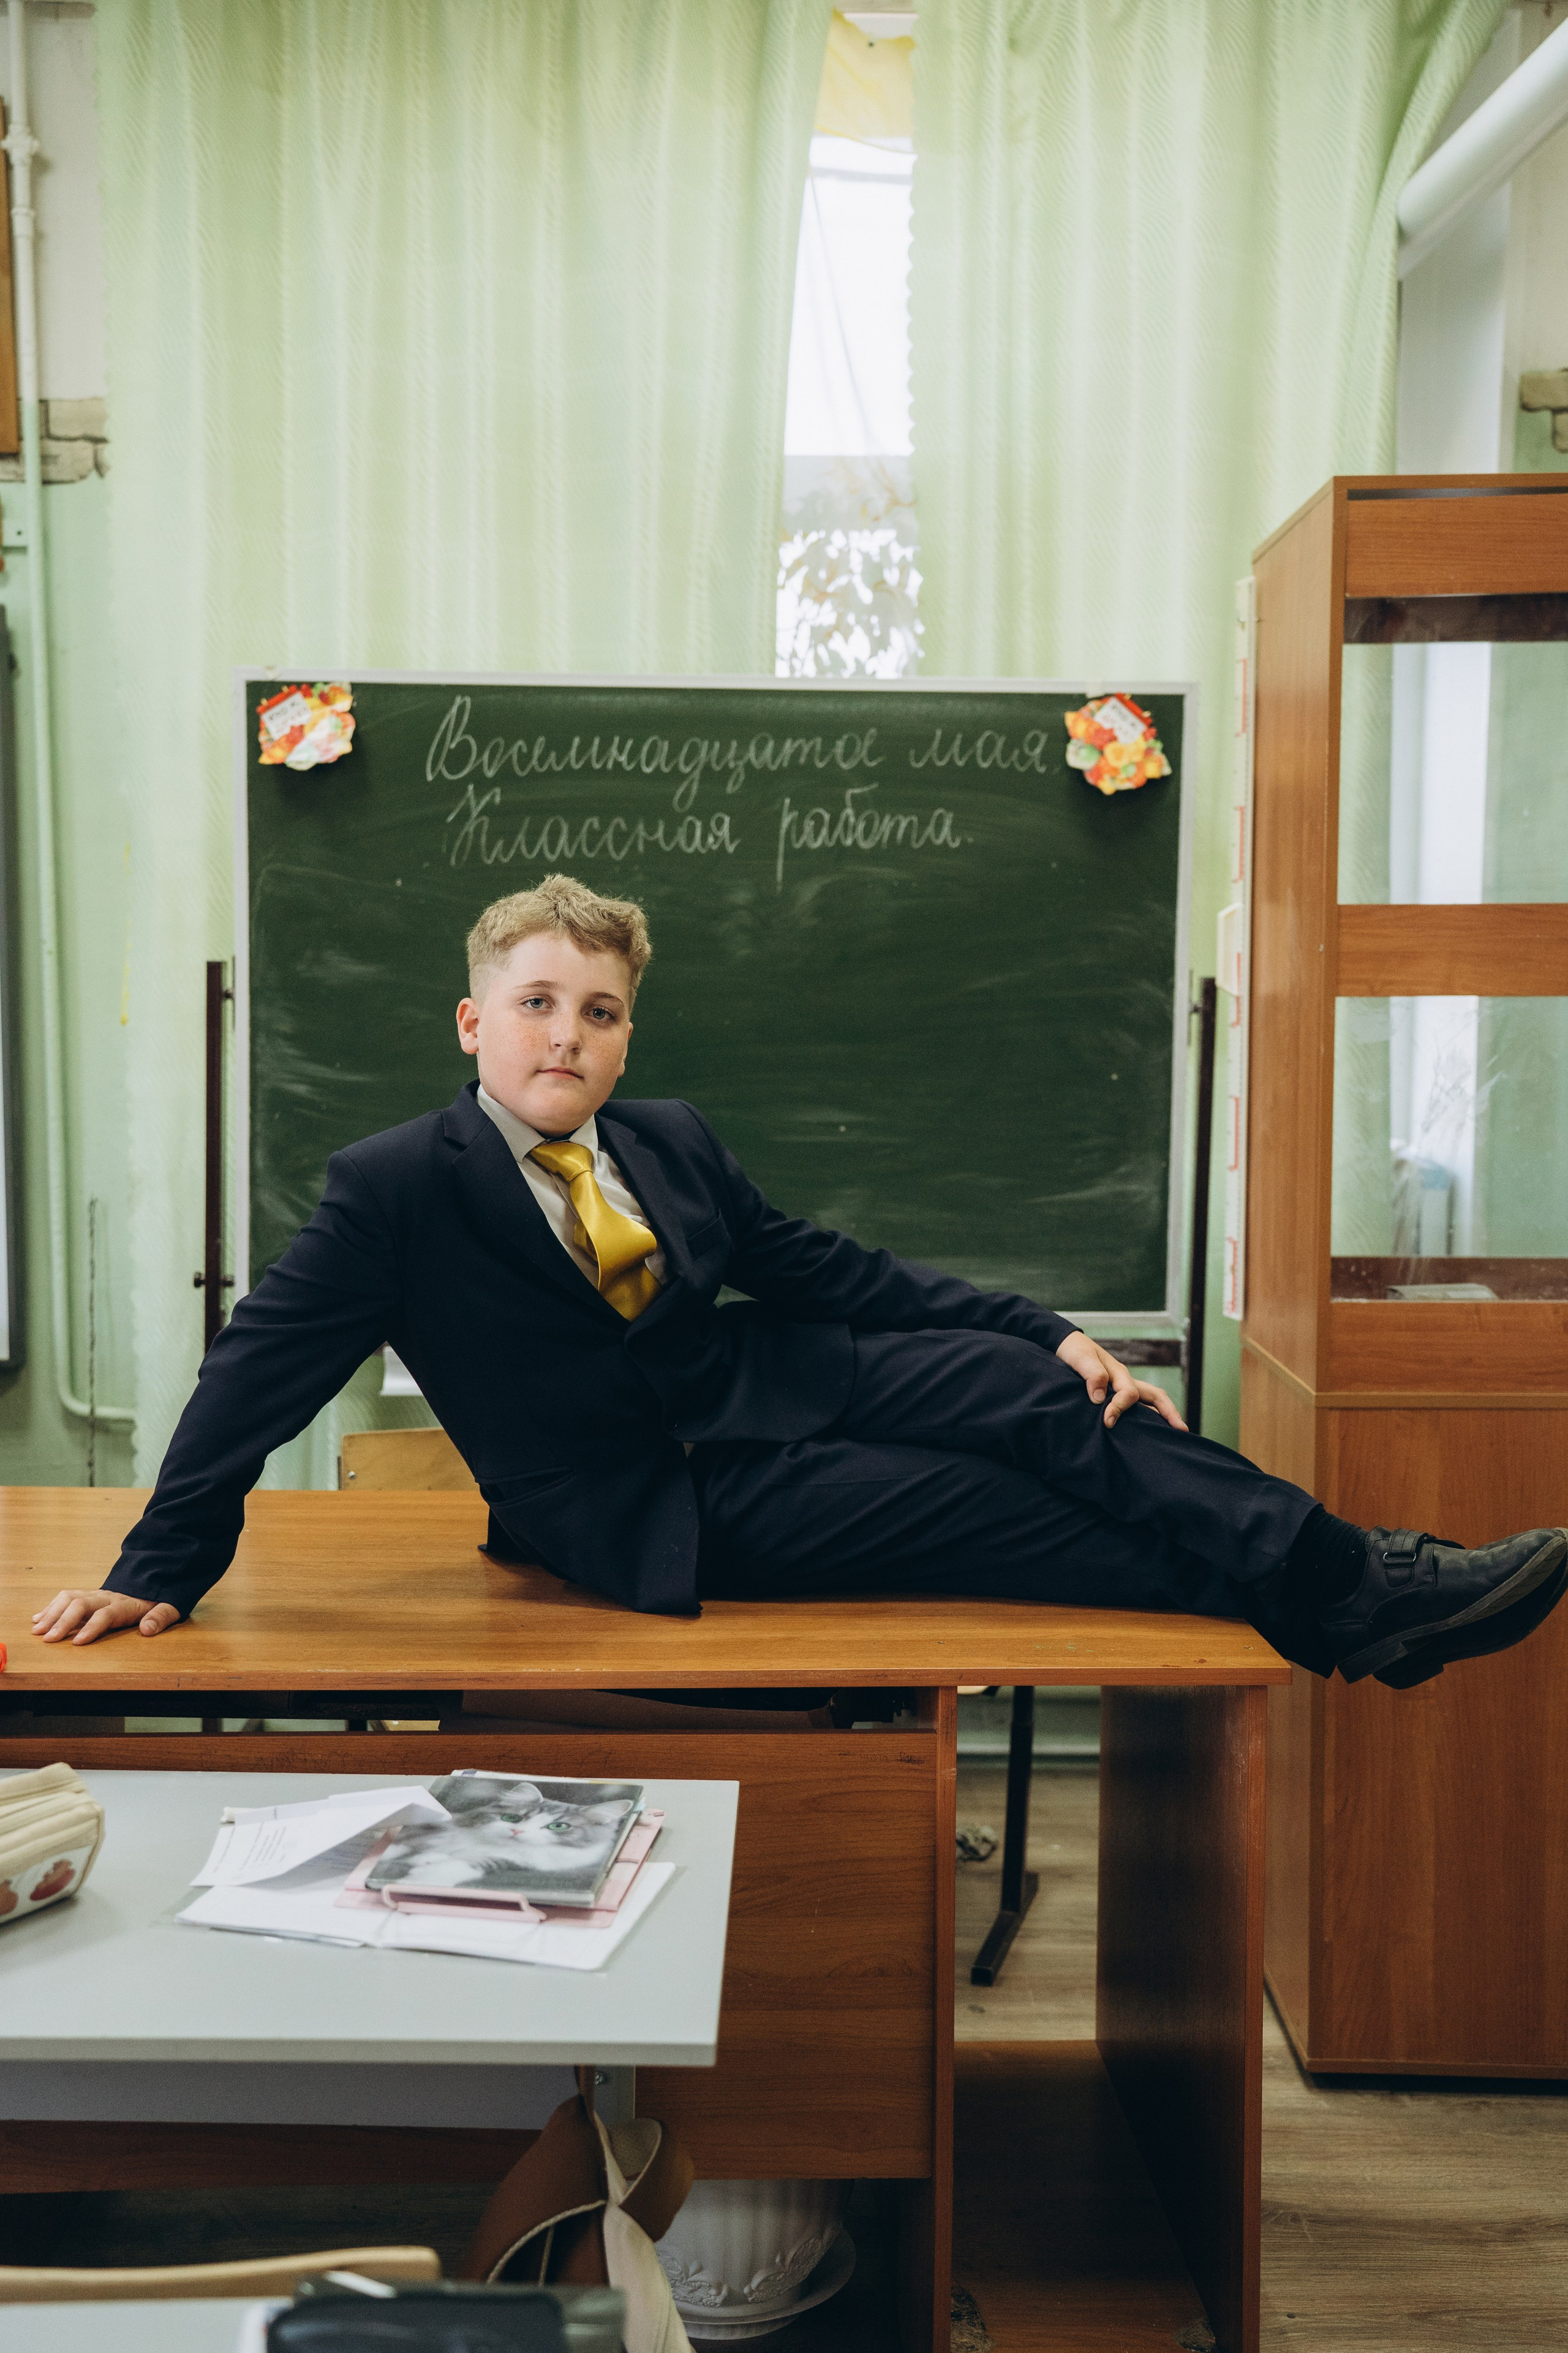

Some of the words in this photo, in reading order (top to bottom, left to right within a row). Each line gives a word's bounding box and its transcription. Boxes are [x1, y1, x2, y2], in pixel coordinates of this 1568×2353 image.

[426, 695, 886, 812] Восемнадцатое
[447, 783, 741, 866] Классная
[774, 782, 974, 894] работа.
